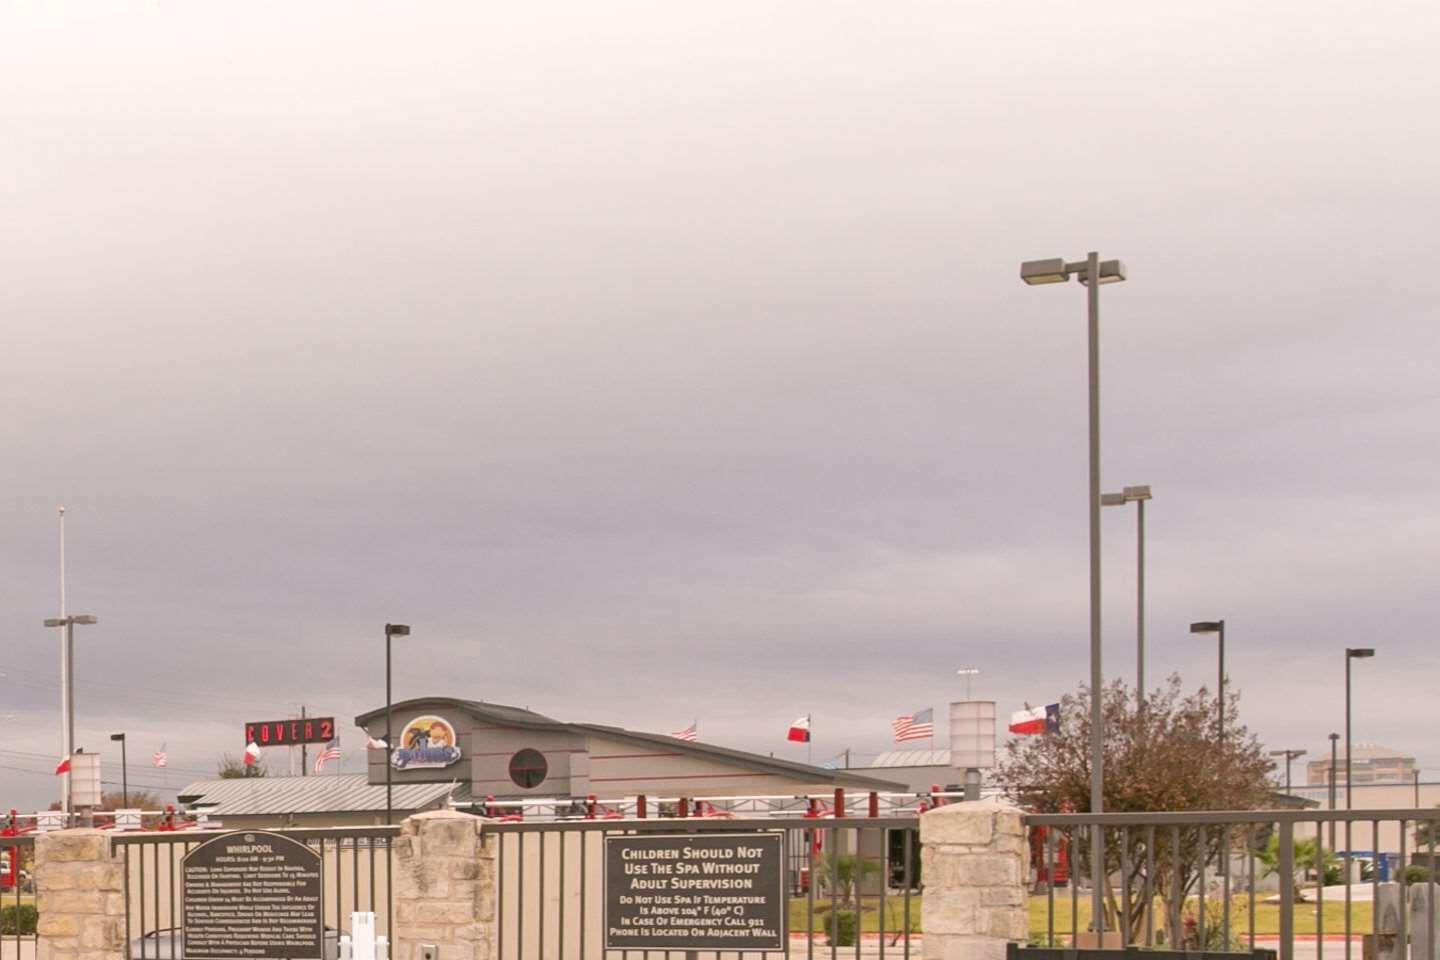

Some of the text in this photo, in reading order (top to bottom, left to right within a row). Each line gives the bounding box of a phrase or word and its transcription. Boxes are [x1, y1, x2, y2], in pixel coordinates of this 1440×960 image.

[622, 847, 763, 859] CHILDREN SHOULD NOT
[625, 862, 760, 874] USE THE SPA WITHOUT
[631, 877, 752, 889] ADULT SUPERVISION
[620, 896, 766, 904] DO NOT USE SPA IF TEMPERATURE
[640, 907, 648, 915] IS
[651, 906, 679, 914] ABOVE
[704, 906, 709, 914] F
[621, 917, 764, 927] IN CASE OF EMERGENCY CALL 911
[610, 928, 777, 938] PHONE IS LOCATED ON ADJACENT WALL
